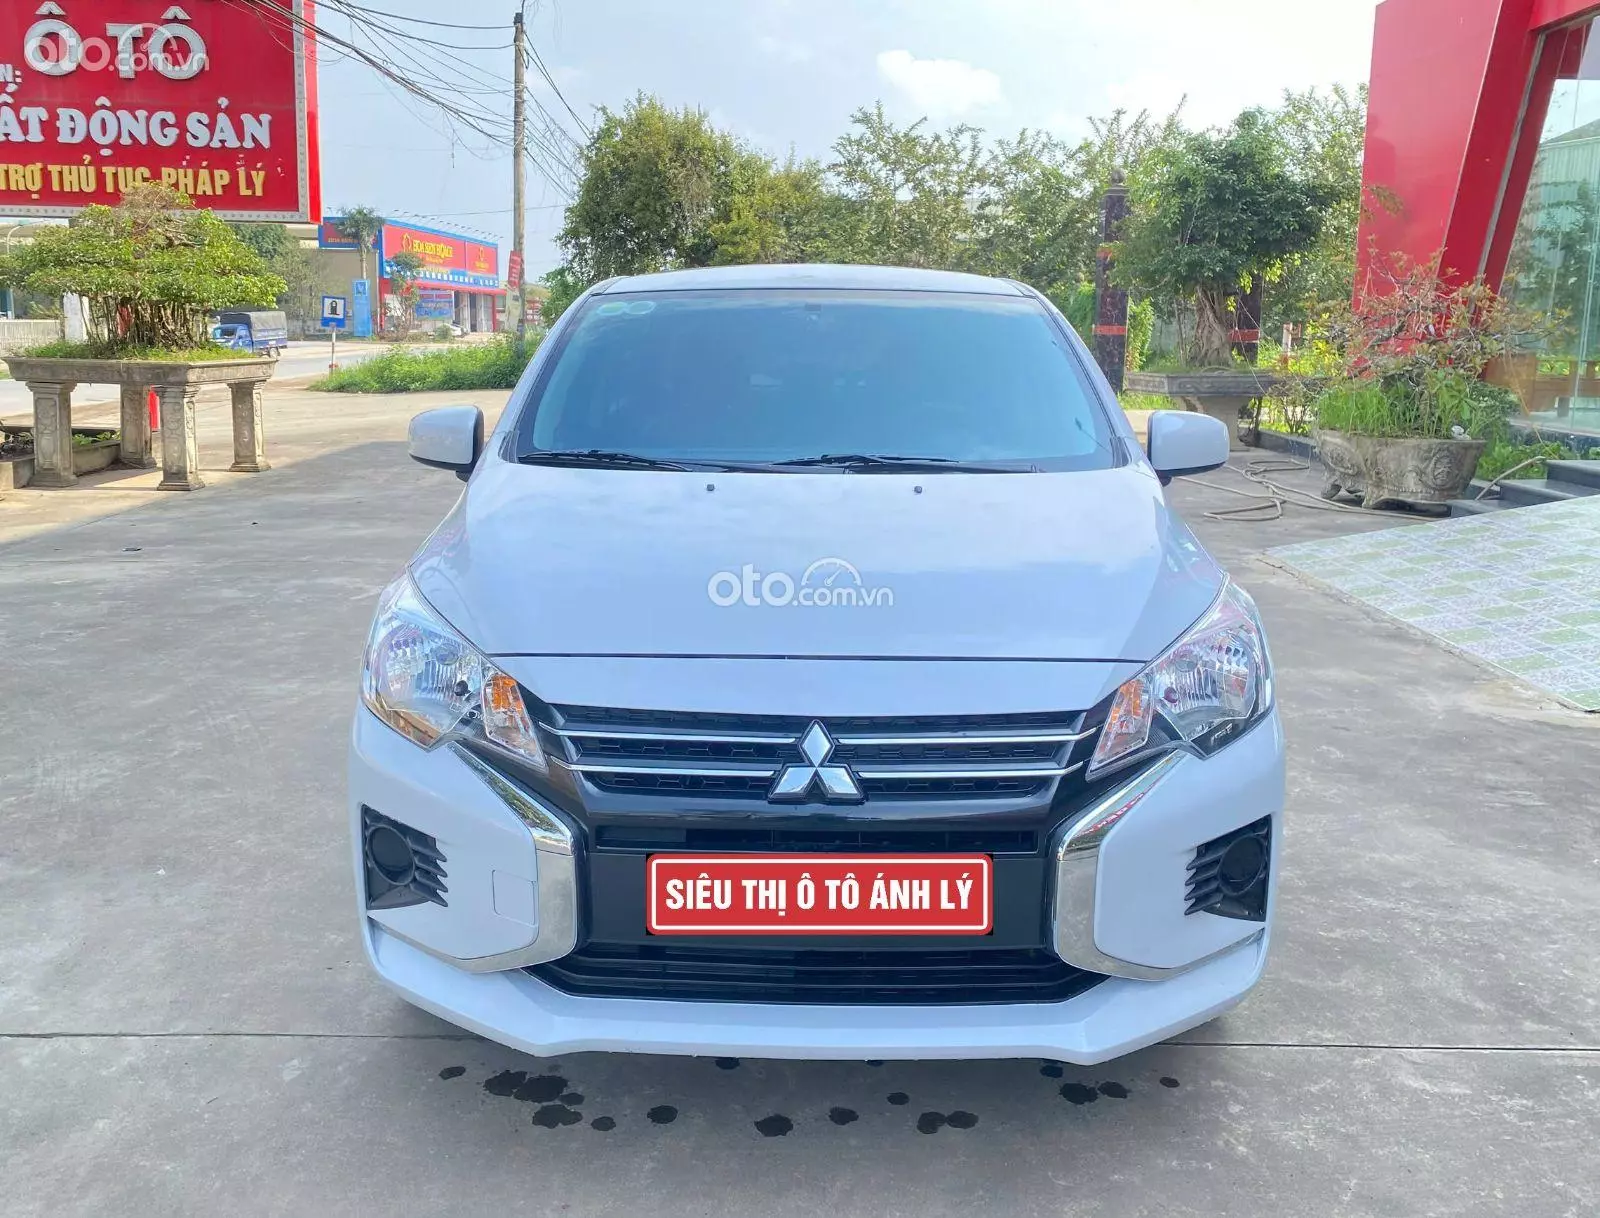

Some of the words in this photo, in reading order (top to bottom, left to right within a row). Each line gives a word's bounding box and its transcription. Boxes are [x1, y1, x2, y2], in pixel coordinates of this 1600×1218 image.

[24, 1, 82, 76] Ô
[106, 6, 206, 80] TÔ
[56, 96, 180, 157] ĐỘNG
[185, 97, 272, 149] SẢN
[47, 155, 97, 193] THỦ
[161, 160, 230, 196] PHÁP
[238, 162, 266, 197] LÝ
